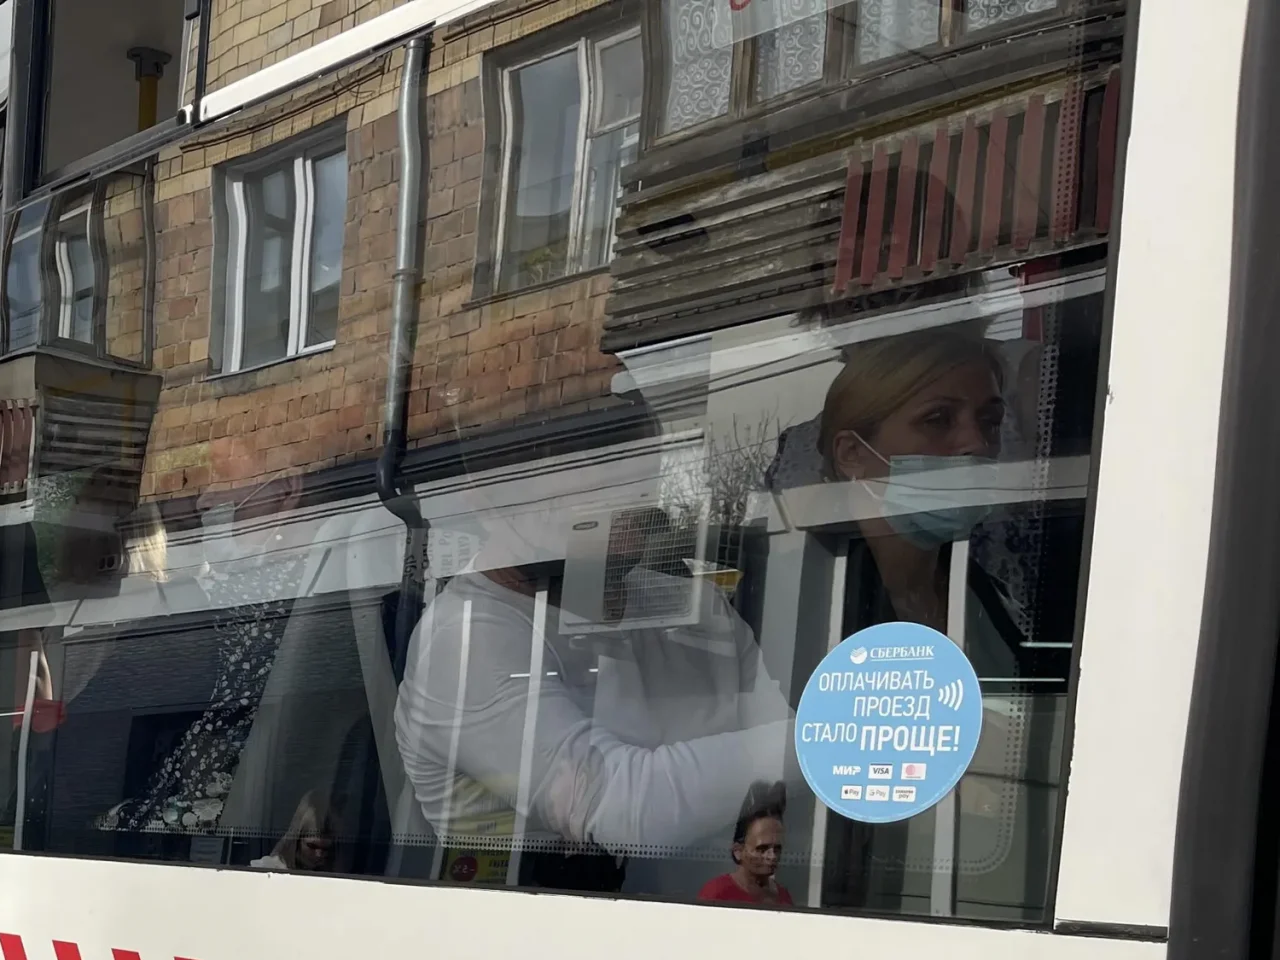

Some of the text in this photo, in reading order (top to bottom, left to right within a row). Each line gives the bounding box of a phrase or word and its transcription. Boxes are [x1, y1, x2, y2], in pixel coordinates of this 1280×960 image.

[870, 645, 935, 659] СБЕРБАНК
[818, 670, 935, 692] ОПЛАЧИВАТЬ
[853, 695, 931, 720] ПРОЕЗД
[801, 722, 961, 757] СТАЛО ПРОЩЕ!
[832, 765, 862, 776] МИР
[872, 767, 890, 775] VISA
